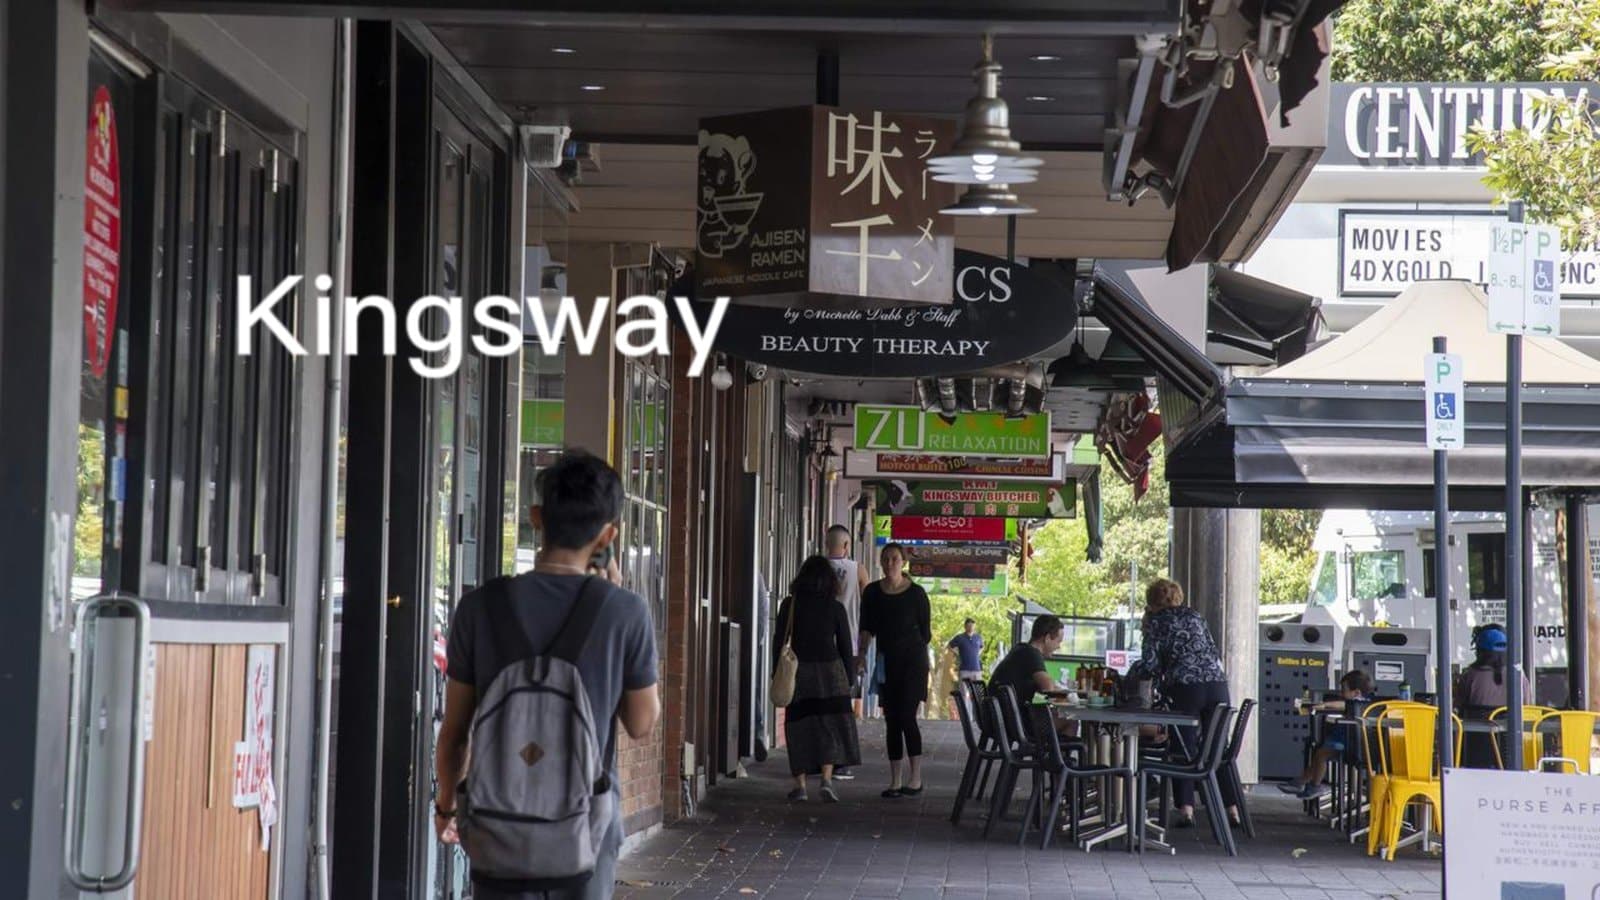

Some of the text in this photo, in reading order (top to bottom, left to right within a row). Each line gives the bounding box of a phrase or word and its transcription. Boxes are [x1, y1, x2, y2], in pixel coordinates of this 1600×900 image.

[826, 110, 904, 297] 味千
[750, 228, 806, 248] AJISEN
[1352, 228, 1442, 252] MOVIES
[1537, 231, 1551, 257] P
[751, 248, 806, 268] RAMEN
[956, 265, 1012, 303] CS
[1533, 294, 1553, 306] ONLY
[784, 306, 800, 325] by
[904, 309, 920, 328] &
[922, 306, 961, 328] Staff
[760, 335, 991, 357] BEAUTY THERAPY
[1436, 361, 1451, 384] P
[928, 433, 1041, 452] RELAXATION
[923, 490, 1040, 503] KINGSWAY BUTCHER
[1534, 625, 1566, 638] ARD
[1544, 786, 1574, 798] THE
[1478, 798, 1549, 814] PURSE
